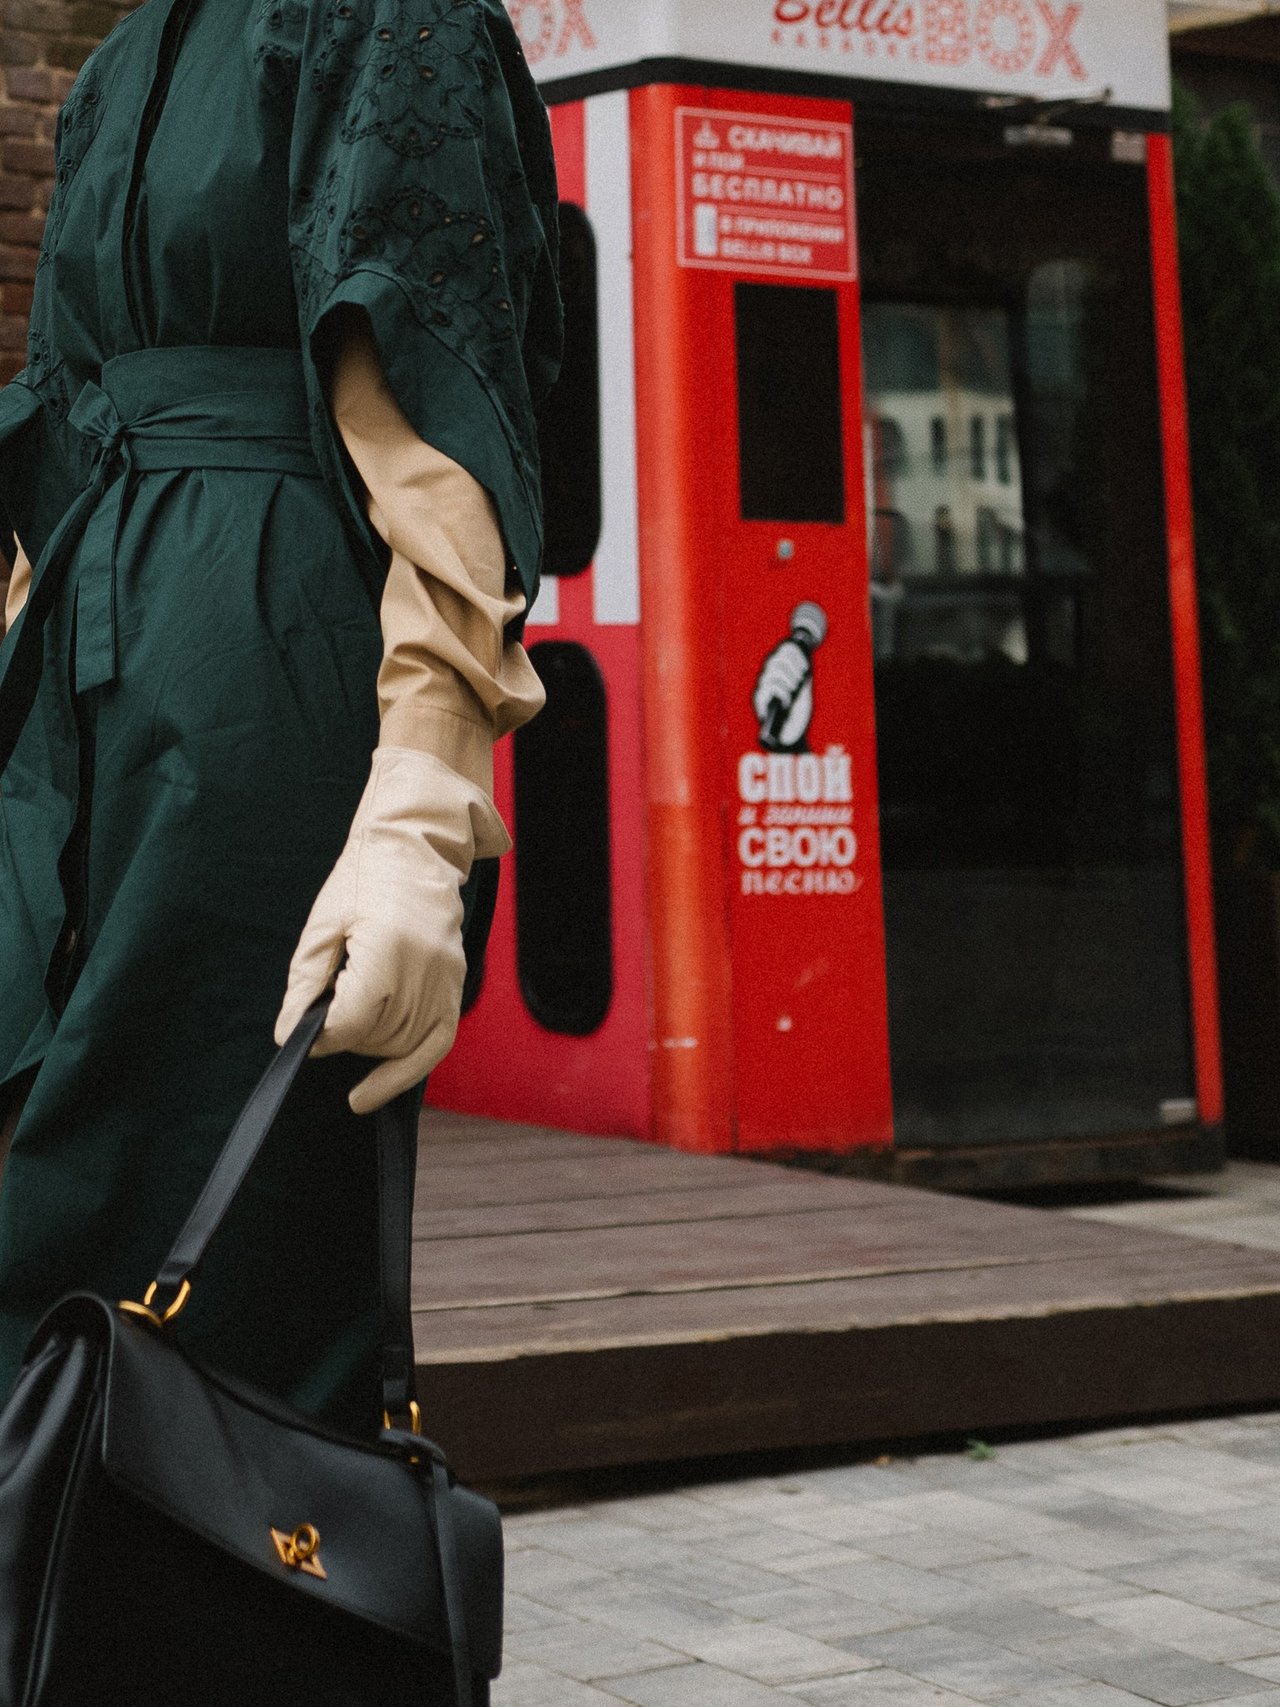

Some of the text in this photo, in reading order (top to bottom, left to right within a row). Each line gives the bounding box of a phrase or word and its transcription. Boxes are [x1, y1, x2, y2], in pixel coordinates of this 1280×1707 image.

[692, 172, 844, 211] БЕСПЛАТНО
[738, 744, 853, 803] СПОЙ
[738, 826, 857, 867] СВОЮ
